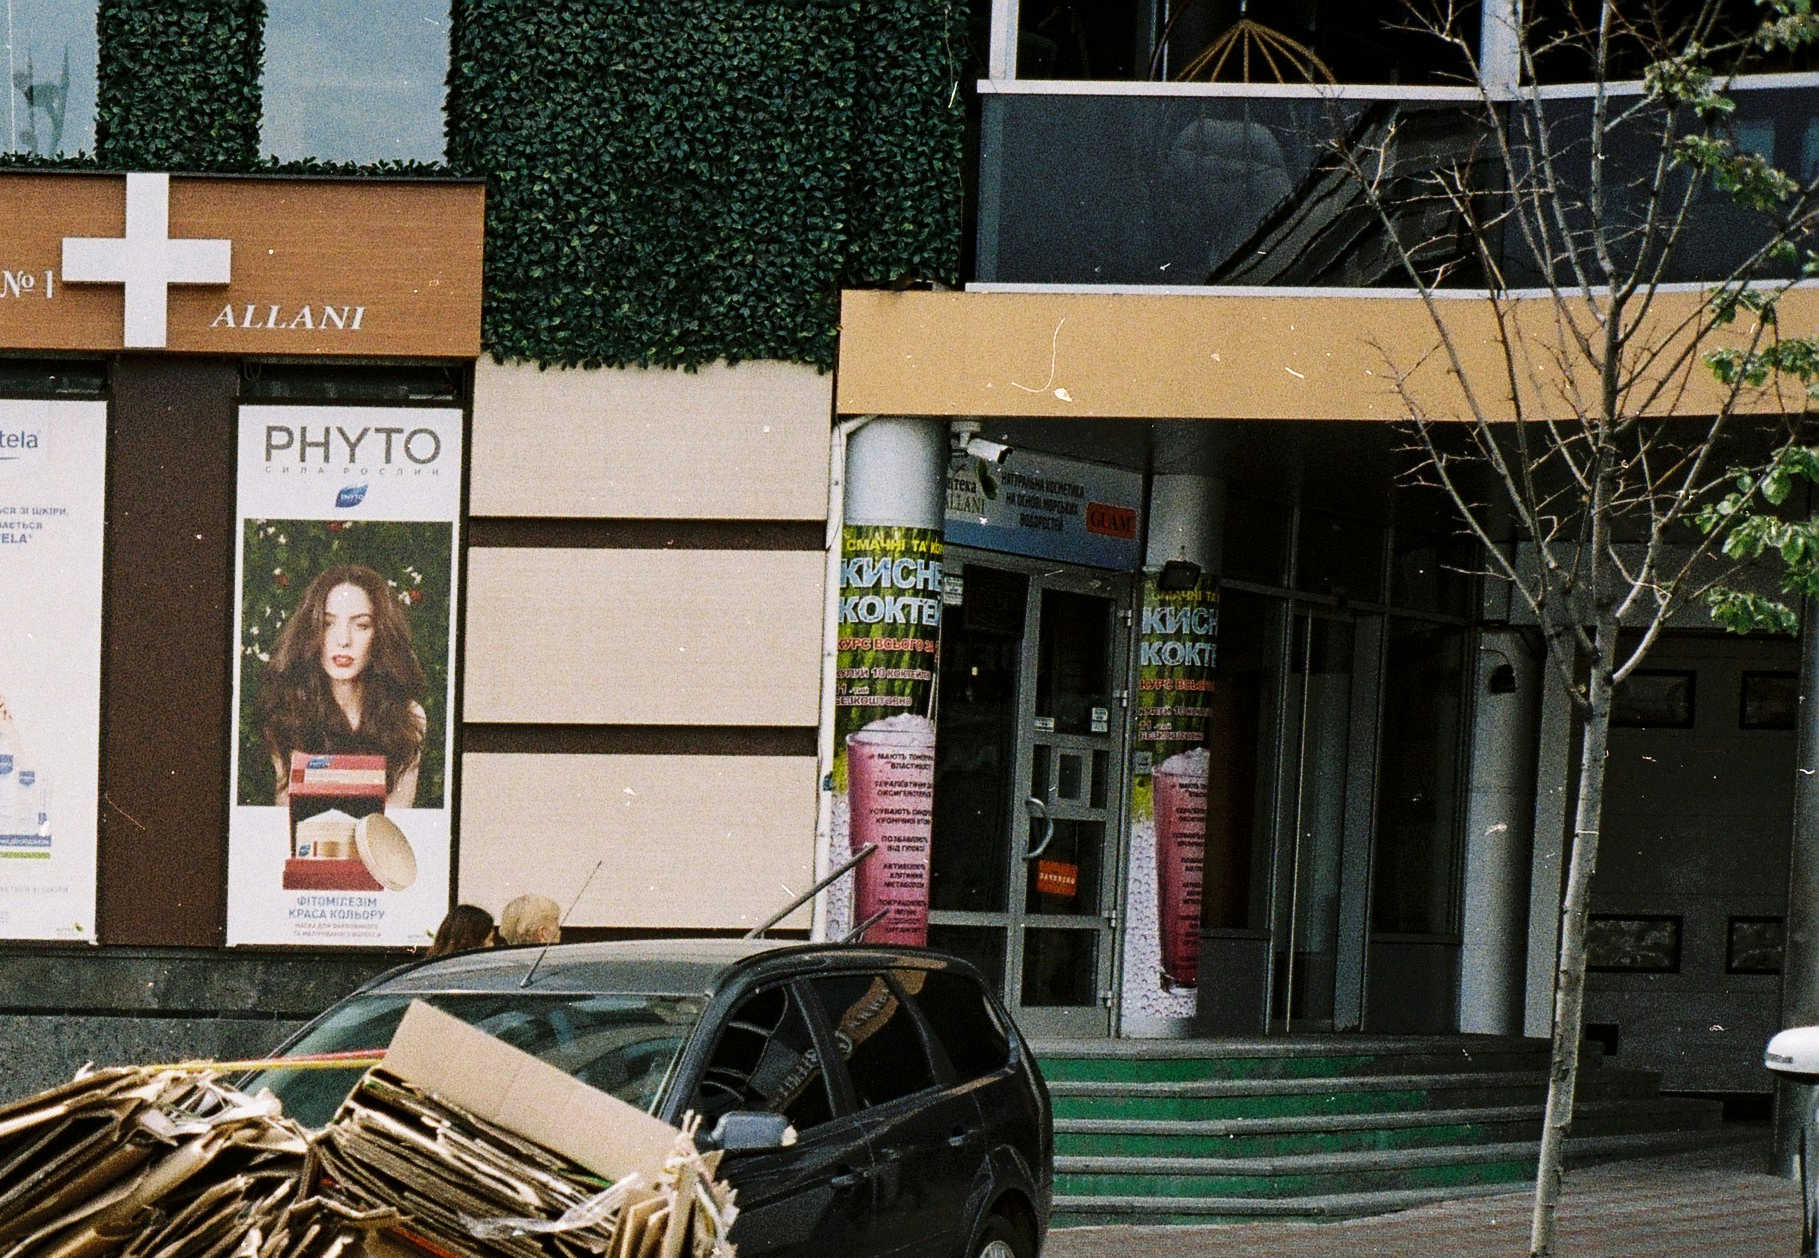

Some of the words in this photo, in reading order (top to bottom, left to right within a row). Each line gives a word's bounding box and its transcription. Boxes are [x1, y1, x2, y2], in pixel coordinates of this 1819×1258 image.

[210, 303, 366, 331] ALLANI
[265, 425, 442, 465] PHYTO
[265, 466, 325, 475] СИЛА
[343, 467, 440, 477] РОСЛИН
[20, 507, 29, 515] ЗІ
[846, 538, 906, 551] СМАЧНІ
[912, 540, 927, 552] ТА
[873, 637, 924, 652] ВСЬОГО
[871, 667, 886, 679] 10
[289, 909, 327, 919] КРАСА
[330, 909, 385, 920] КОЛЬОРУ
